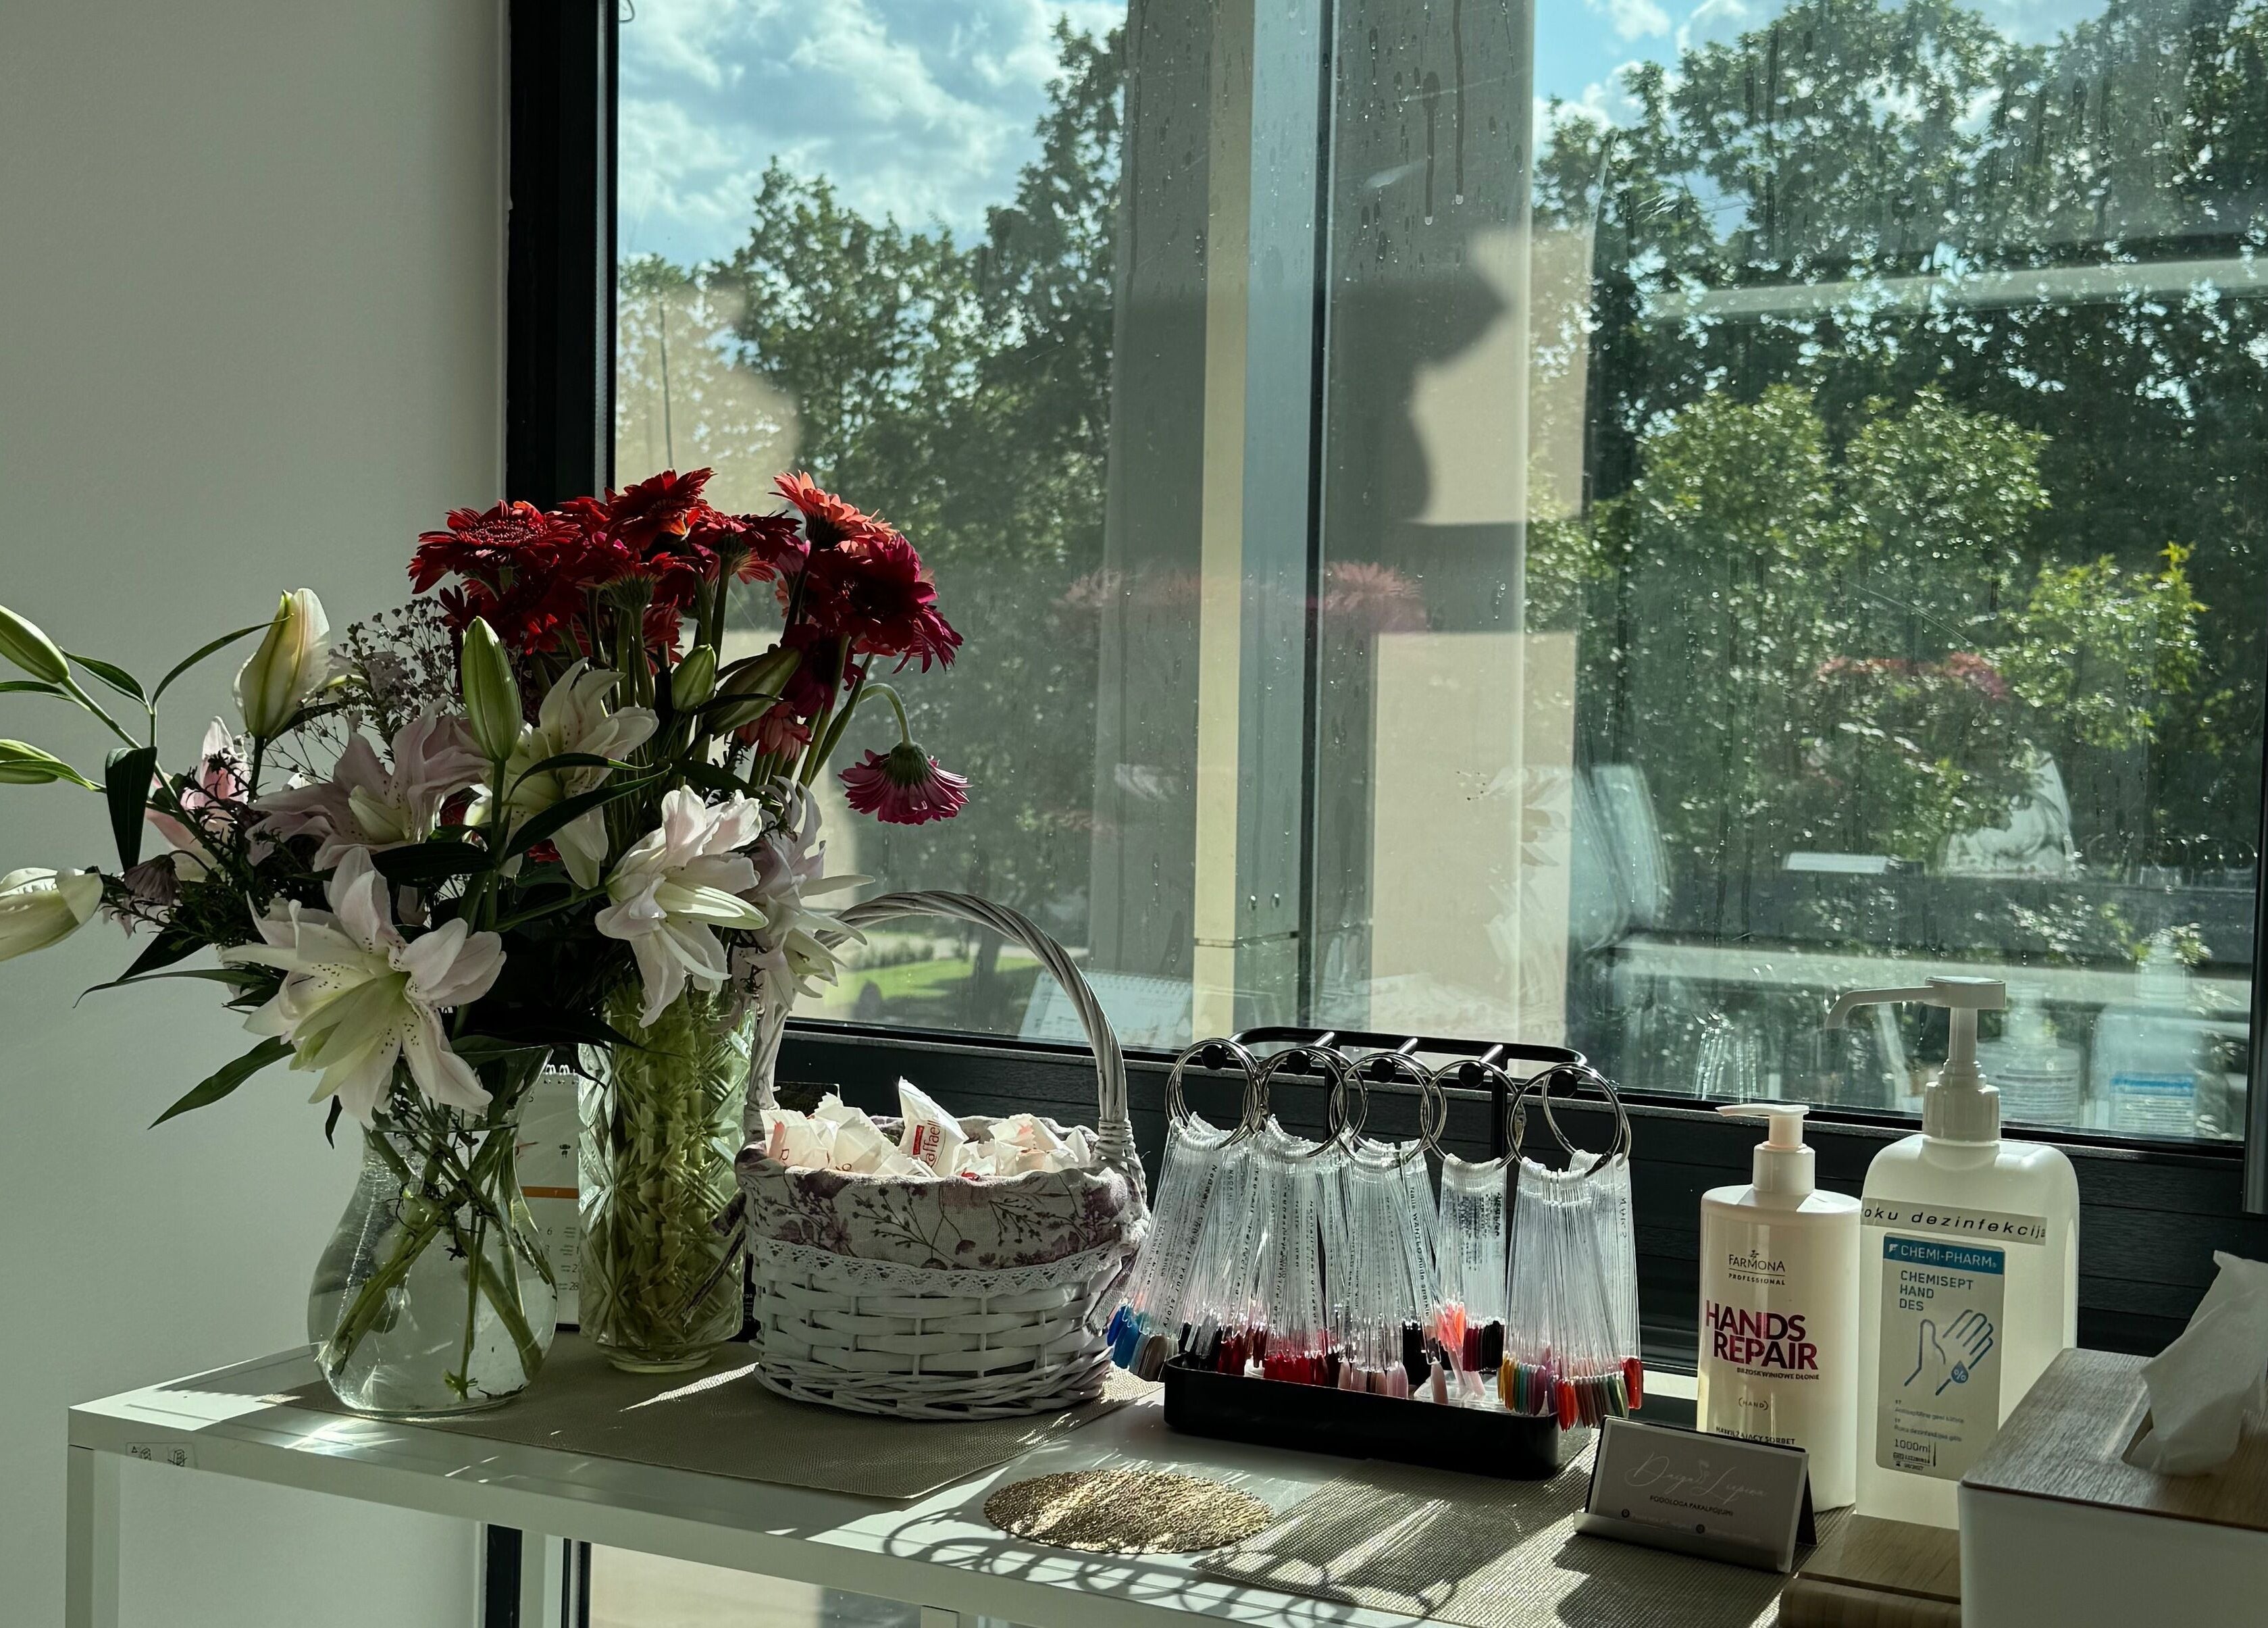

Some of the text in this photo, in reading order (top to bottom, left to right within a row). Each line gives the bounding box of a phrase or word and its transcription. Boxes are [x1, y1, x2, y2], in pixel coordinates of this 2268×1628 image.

[1861, 1206, 1899, 1221] oku
[1729, 1254, 1785, 1272] FARMONA
[1728, 1273, 1785, 1286] PROFESSIONAL
[1901, 1270, 1974, 1290] CHEMISEPT
[1900, 1283, 1934, 1298] HAND
[1899, 1298, 1924, 1311] DES
[1705, 1300, 1806, 1342] HANDS
[1713, 1330, 1818, 1370] REPAIR
[1765, 1435, 1795, 1445] SORBET
